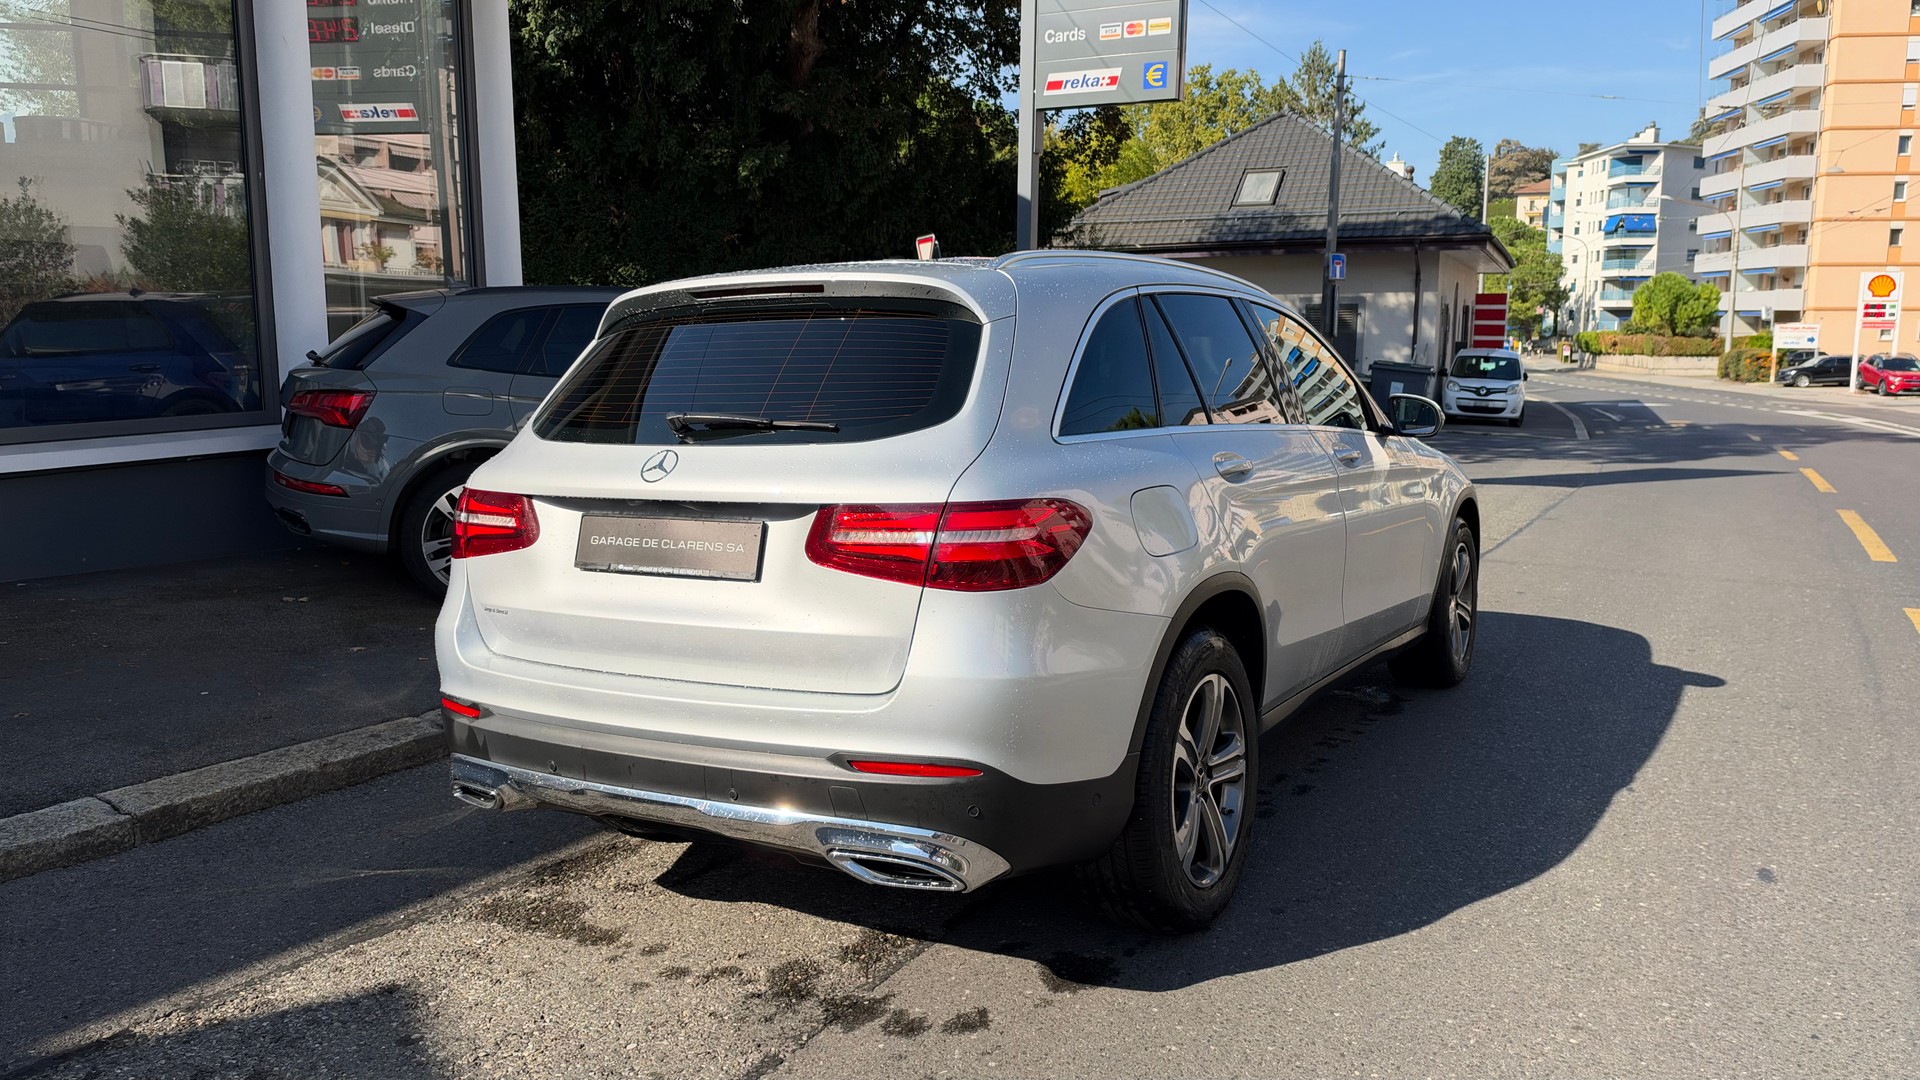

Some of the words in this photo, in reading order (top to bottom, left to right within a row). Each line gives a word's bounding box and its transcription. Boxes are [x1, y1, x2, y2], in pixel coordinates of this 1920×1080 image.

[1044, 27, 1086, 44] Cards
[590, 535, 640, 547] GARAGE
[642, 538, 659, 548] DE
[661, 539, 724, 552] CLARENS
[726, 543, 745, 553] SA
